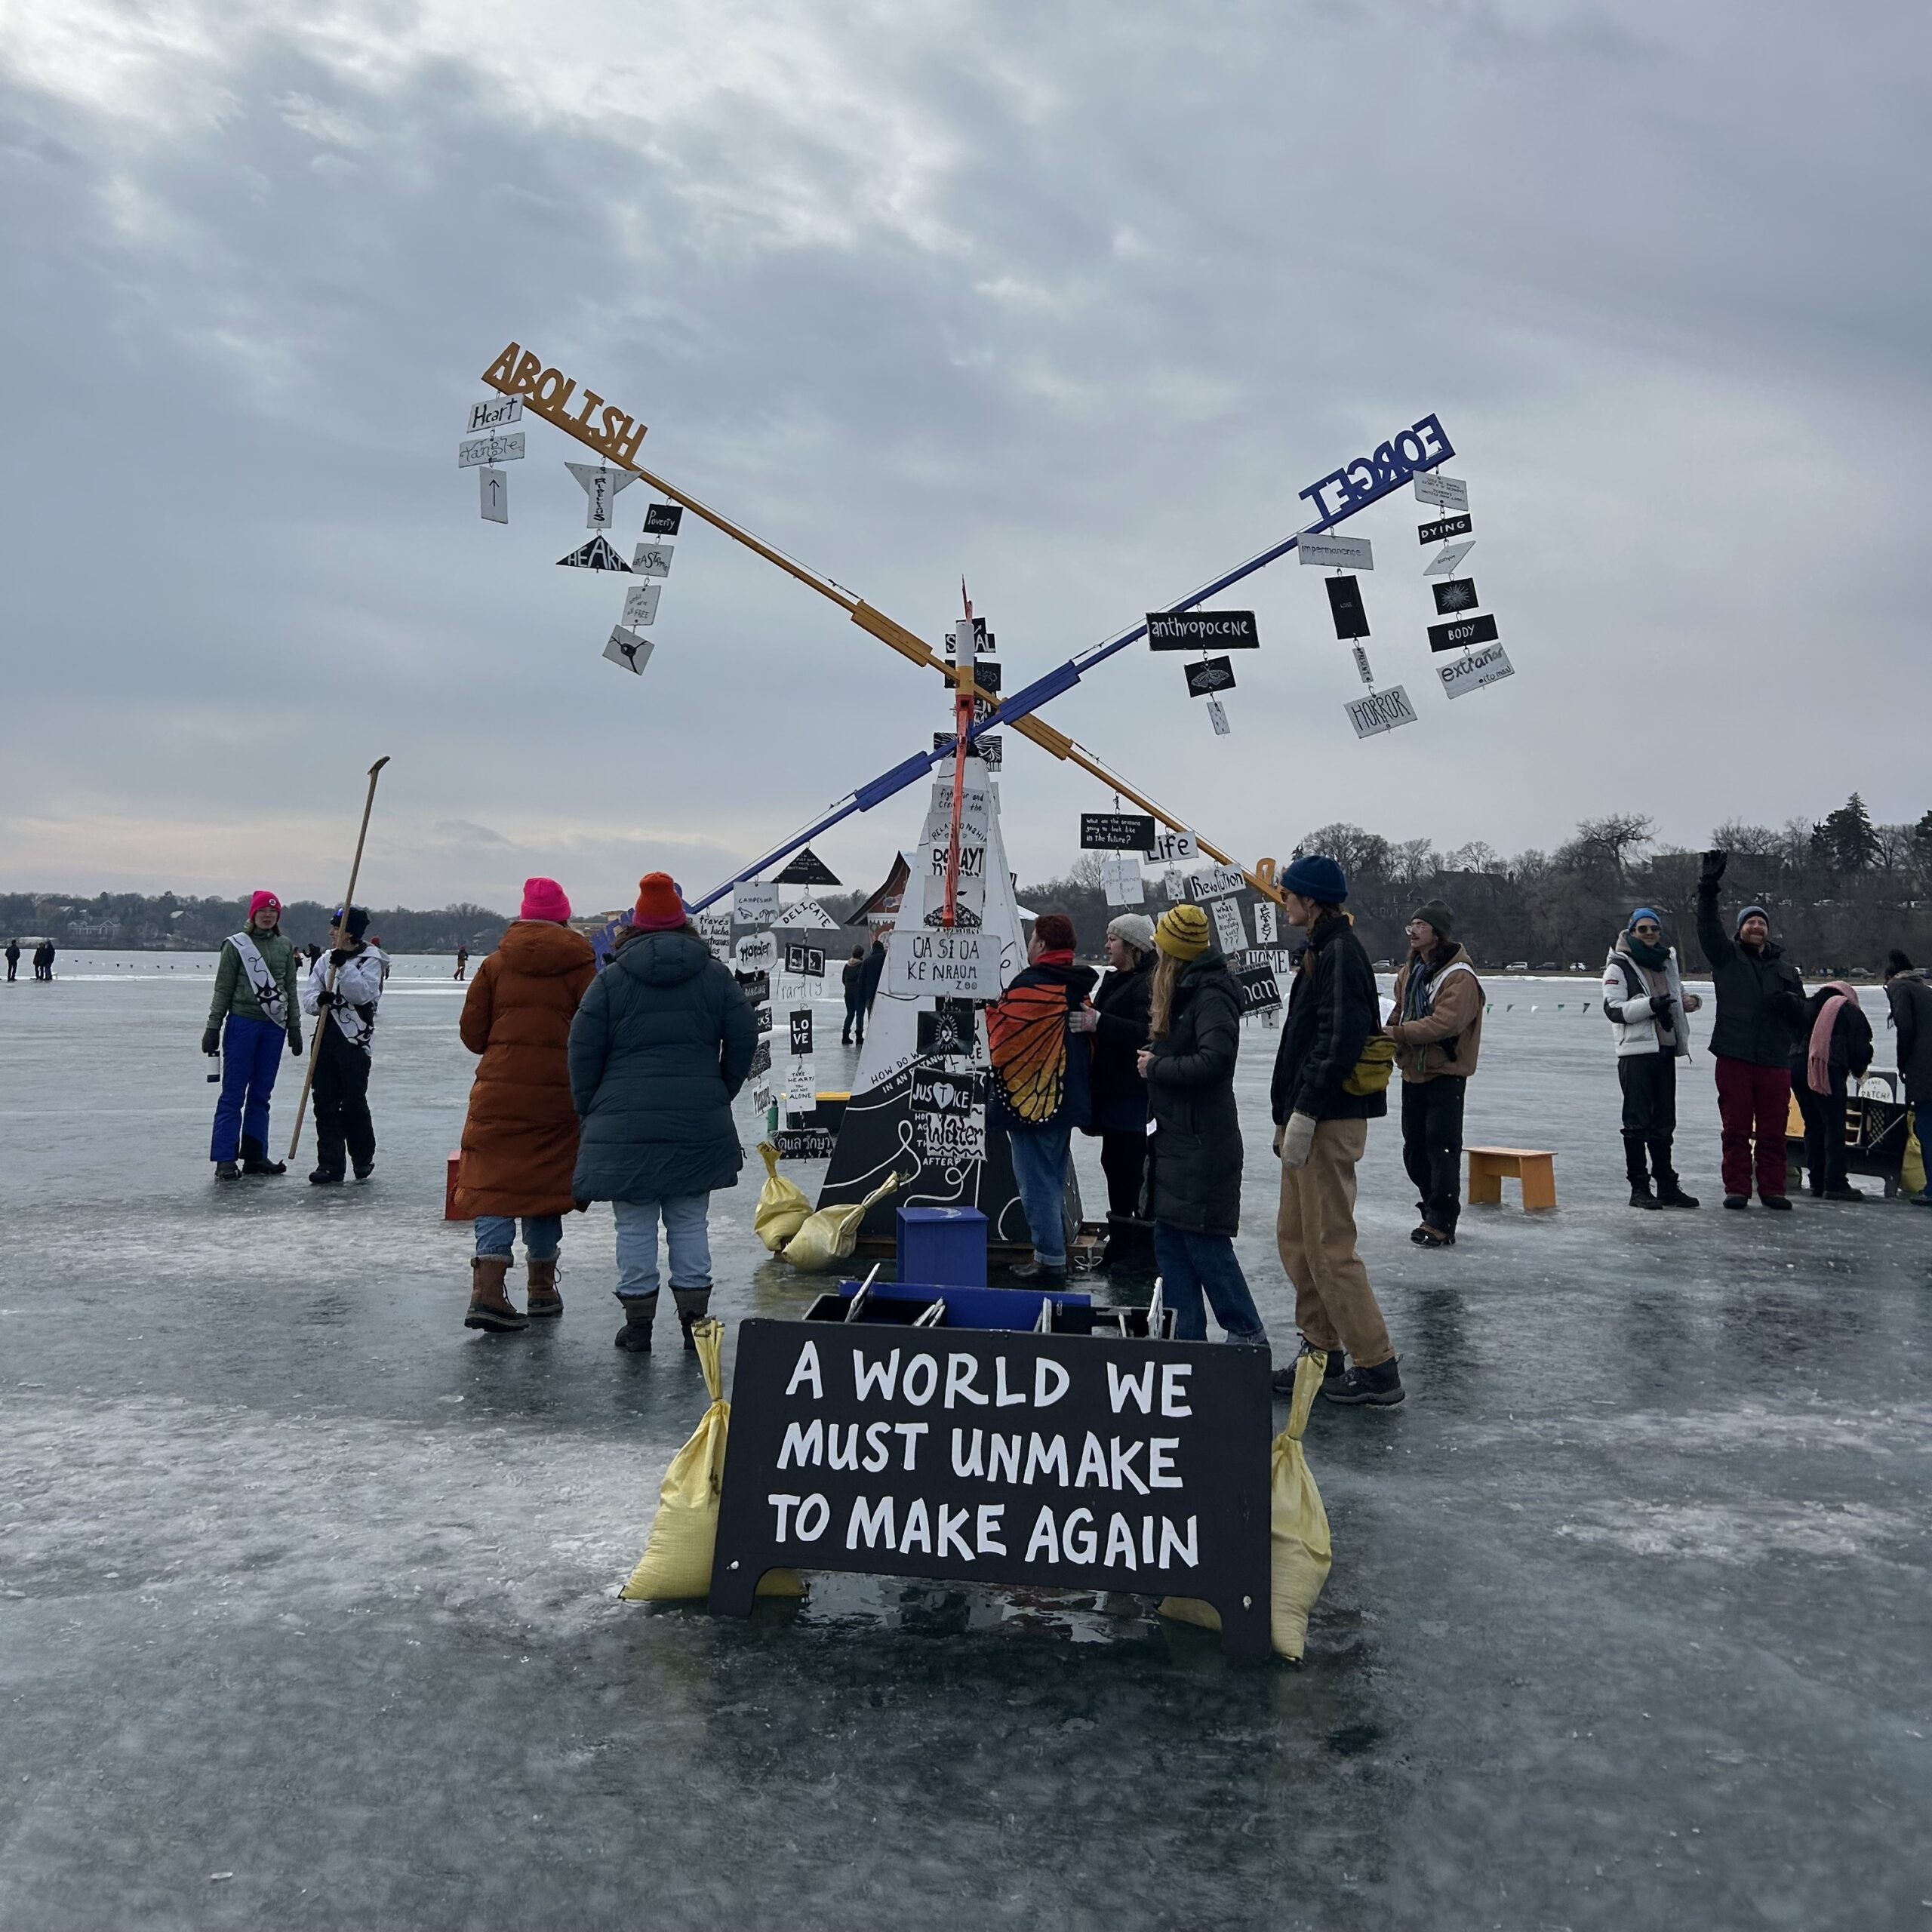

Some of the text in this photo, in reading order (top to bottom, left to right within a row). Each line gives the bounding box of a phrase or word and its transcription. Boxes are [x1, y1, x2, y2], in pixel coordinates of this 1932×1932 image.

[472, 398, 518, 428] Heart
[481, 342, 648, 460] ABOLISH
[648, 510, 675, 531] Poverty
[1422, 521, 1465, 538] DYING
[568, 538, 626, 571] HEART
[1448, 624, 1475, 640] BODY
[1441, 648, 1503, 682] extrañar
[1351, 691, 1411, 731] HORROR
[970, 801, 982, 812] the
[972, 792, 984, 801] and
[1095, 833, 1105, 842] the
[1107, 833, 1131, 844] future?
[1147, 835, 1190, 862] Life
[1191, 869, 1244, 898] Revolution
[700, 915, 729, 925] través
[783, 902, 831, 928] DELICATE
[710, 925, 729, 936] lucha
[907, 961, 927, 980] KE
[1249, 951, 1287, 973] HOME
[792, 1020, 809, 1031] LO
[793, 1033, 809, 1044] VE
[870, 1066, 894, 1084] HOW
[896, 1057, 909, 1069] DO
[881, 1082, 894, 1094] IN
[896, 1073, 908, 1085] AN
[912, 1082, 969, 1109] JUSTICE
[927, 1114, 983, 1146] Water
[786, 1340, 1193, 1418] A WORLD WE
[776, 1419, 1183, 1495] MUST UNMAKE
[768, 1493, 1201, 1571] TO MAKE AGAIN
